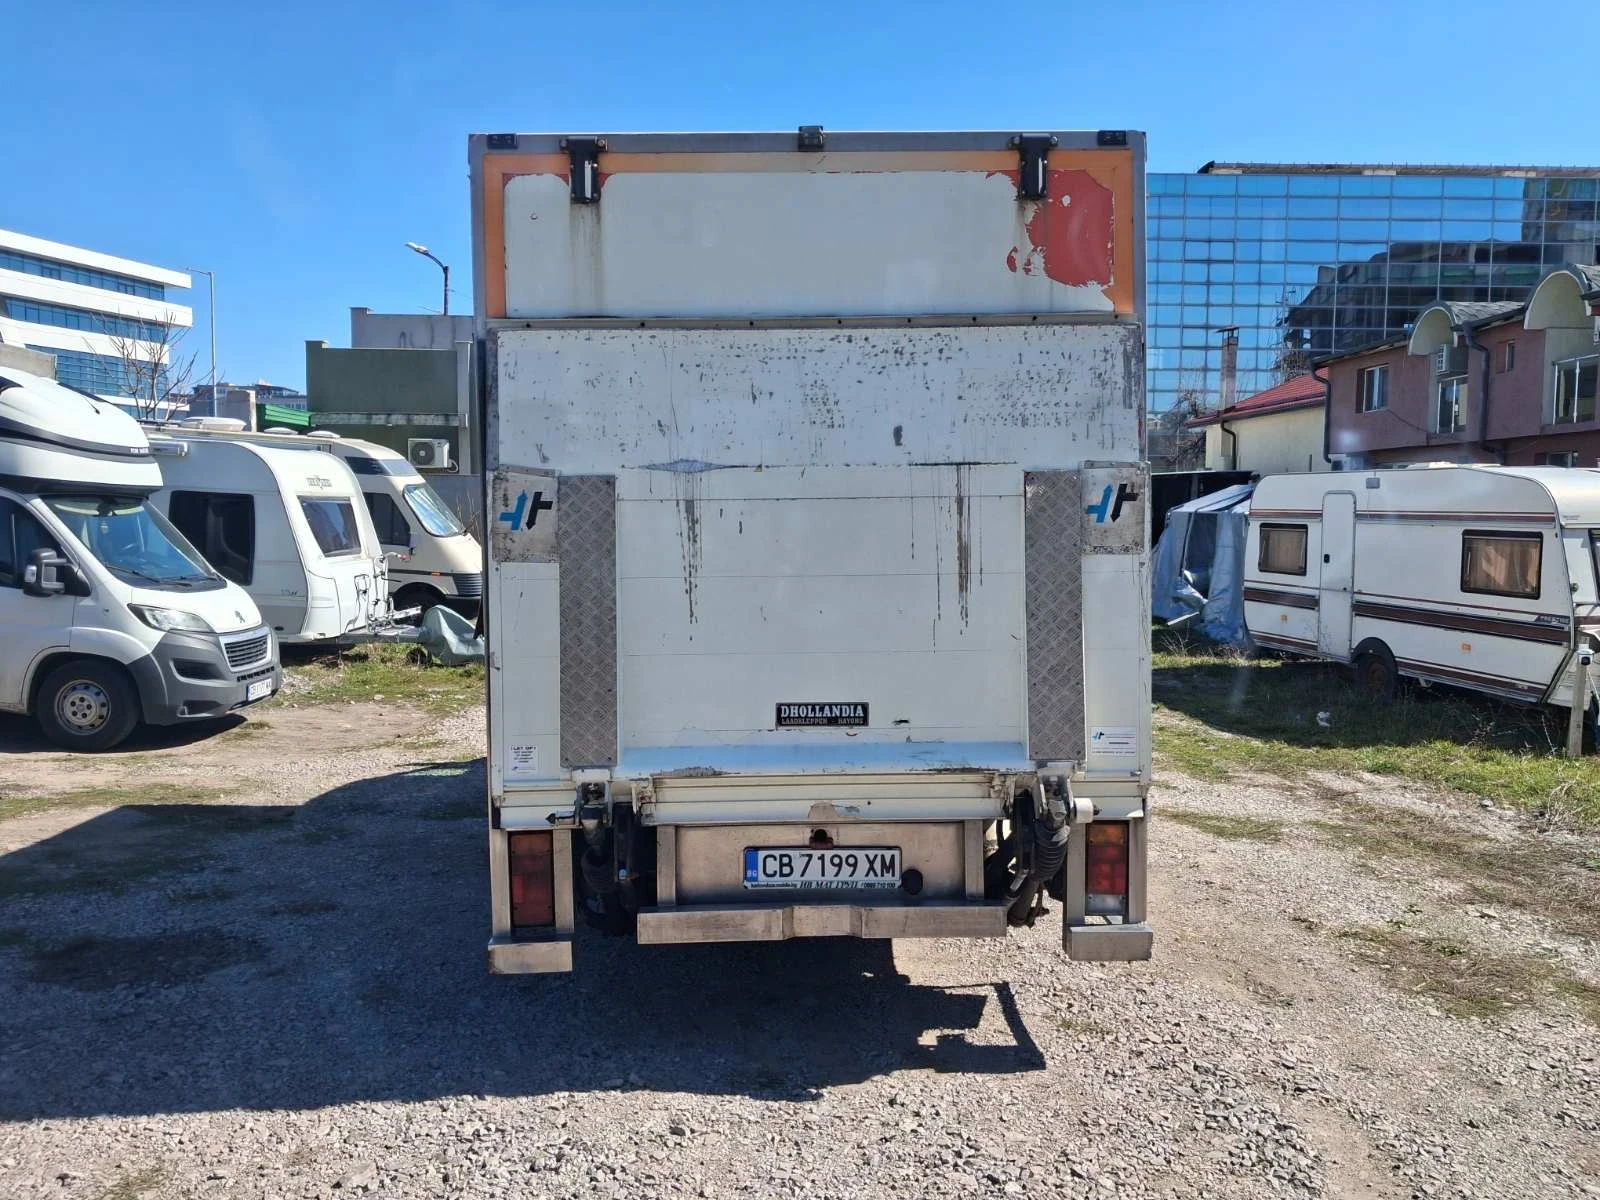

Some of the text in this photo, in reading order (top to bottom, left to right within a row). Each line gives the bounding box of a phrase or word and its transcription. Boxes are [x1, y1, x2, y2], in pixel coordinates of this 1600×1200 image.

[780, 704, 864, 718] DHOLLANDIA
[762, 853, 896, 878] CB 7199 XM
